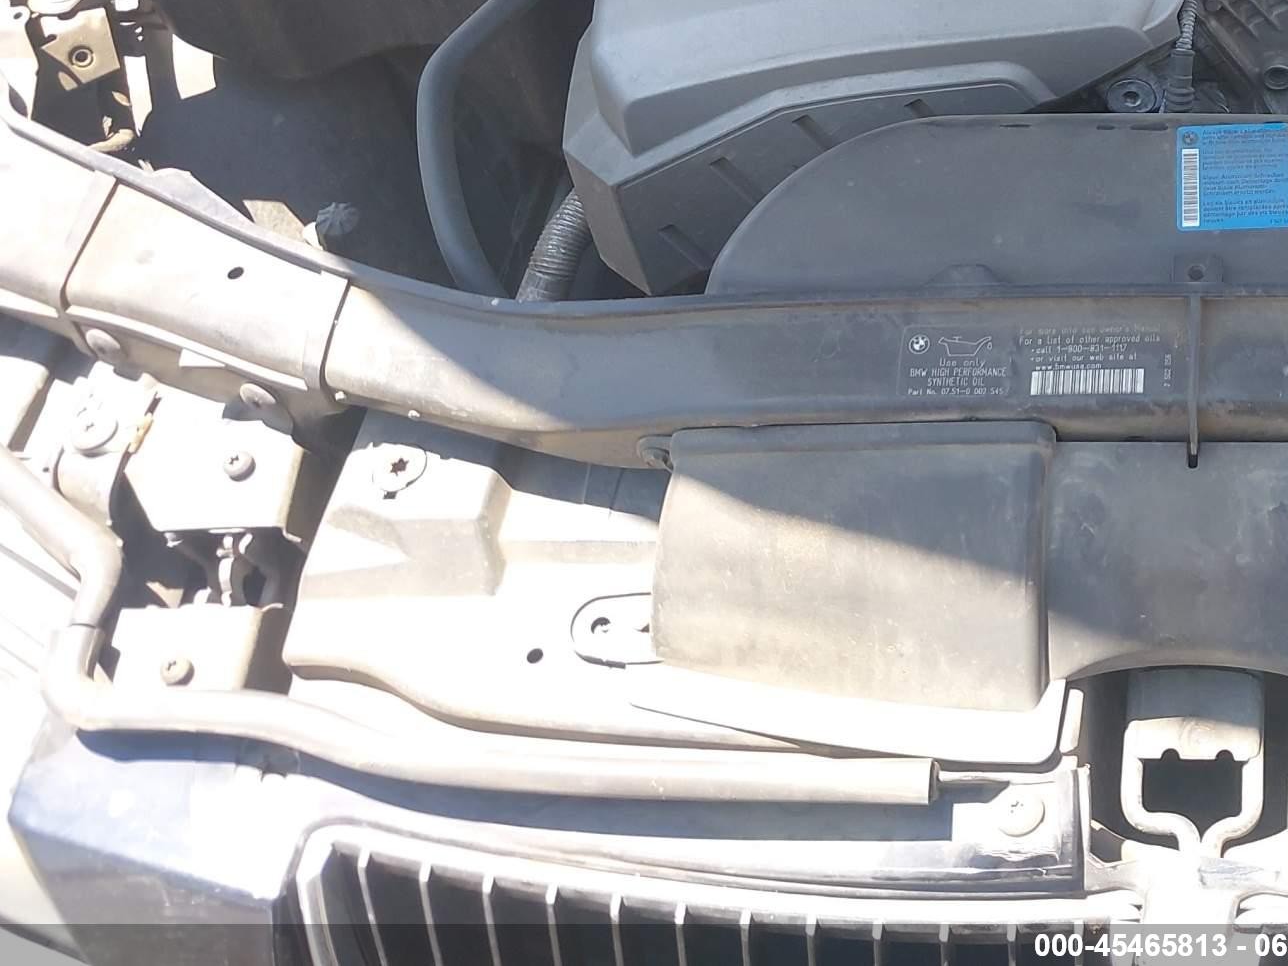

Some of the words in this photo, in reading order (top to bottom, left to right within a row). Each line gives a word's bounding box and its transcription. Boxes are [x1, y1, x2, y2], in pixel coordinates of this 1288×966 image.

[1020, 337, 1032, 346] For
[1047, 336, 1061, 345] list
[1065, 336, 1075, 344] of
[1079, 335, 1101, 344] other
[1104, 335, 1141, 345] approved
[1089, 353, 1104, 361] web
[940, 357, 957, 367] Use
[963, 357, 986, 369] only
[909, 368, 928, 377] BMW
[931, 367, 950, 377] HIGH
[953, 367, 1007, 377] PERFORMANCE
[927, 376, 968, 387] SYNTHETIC
[972, 377, 985, 386] OIL
